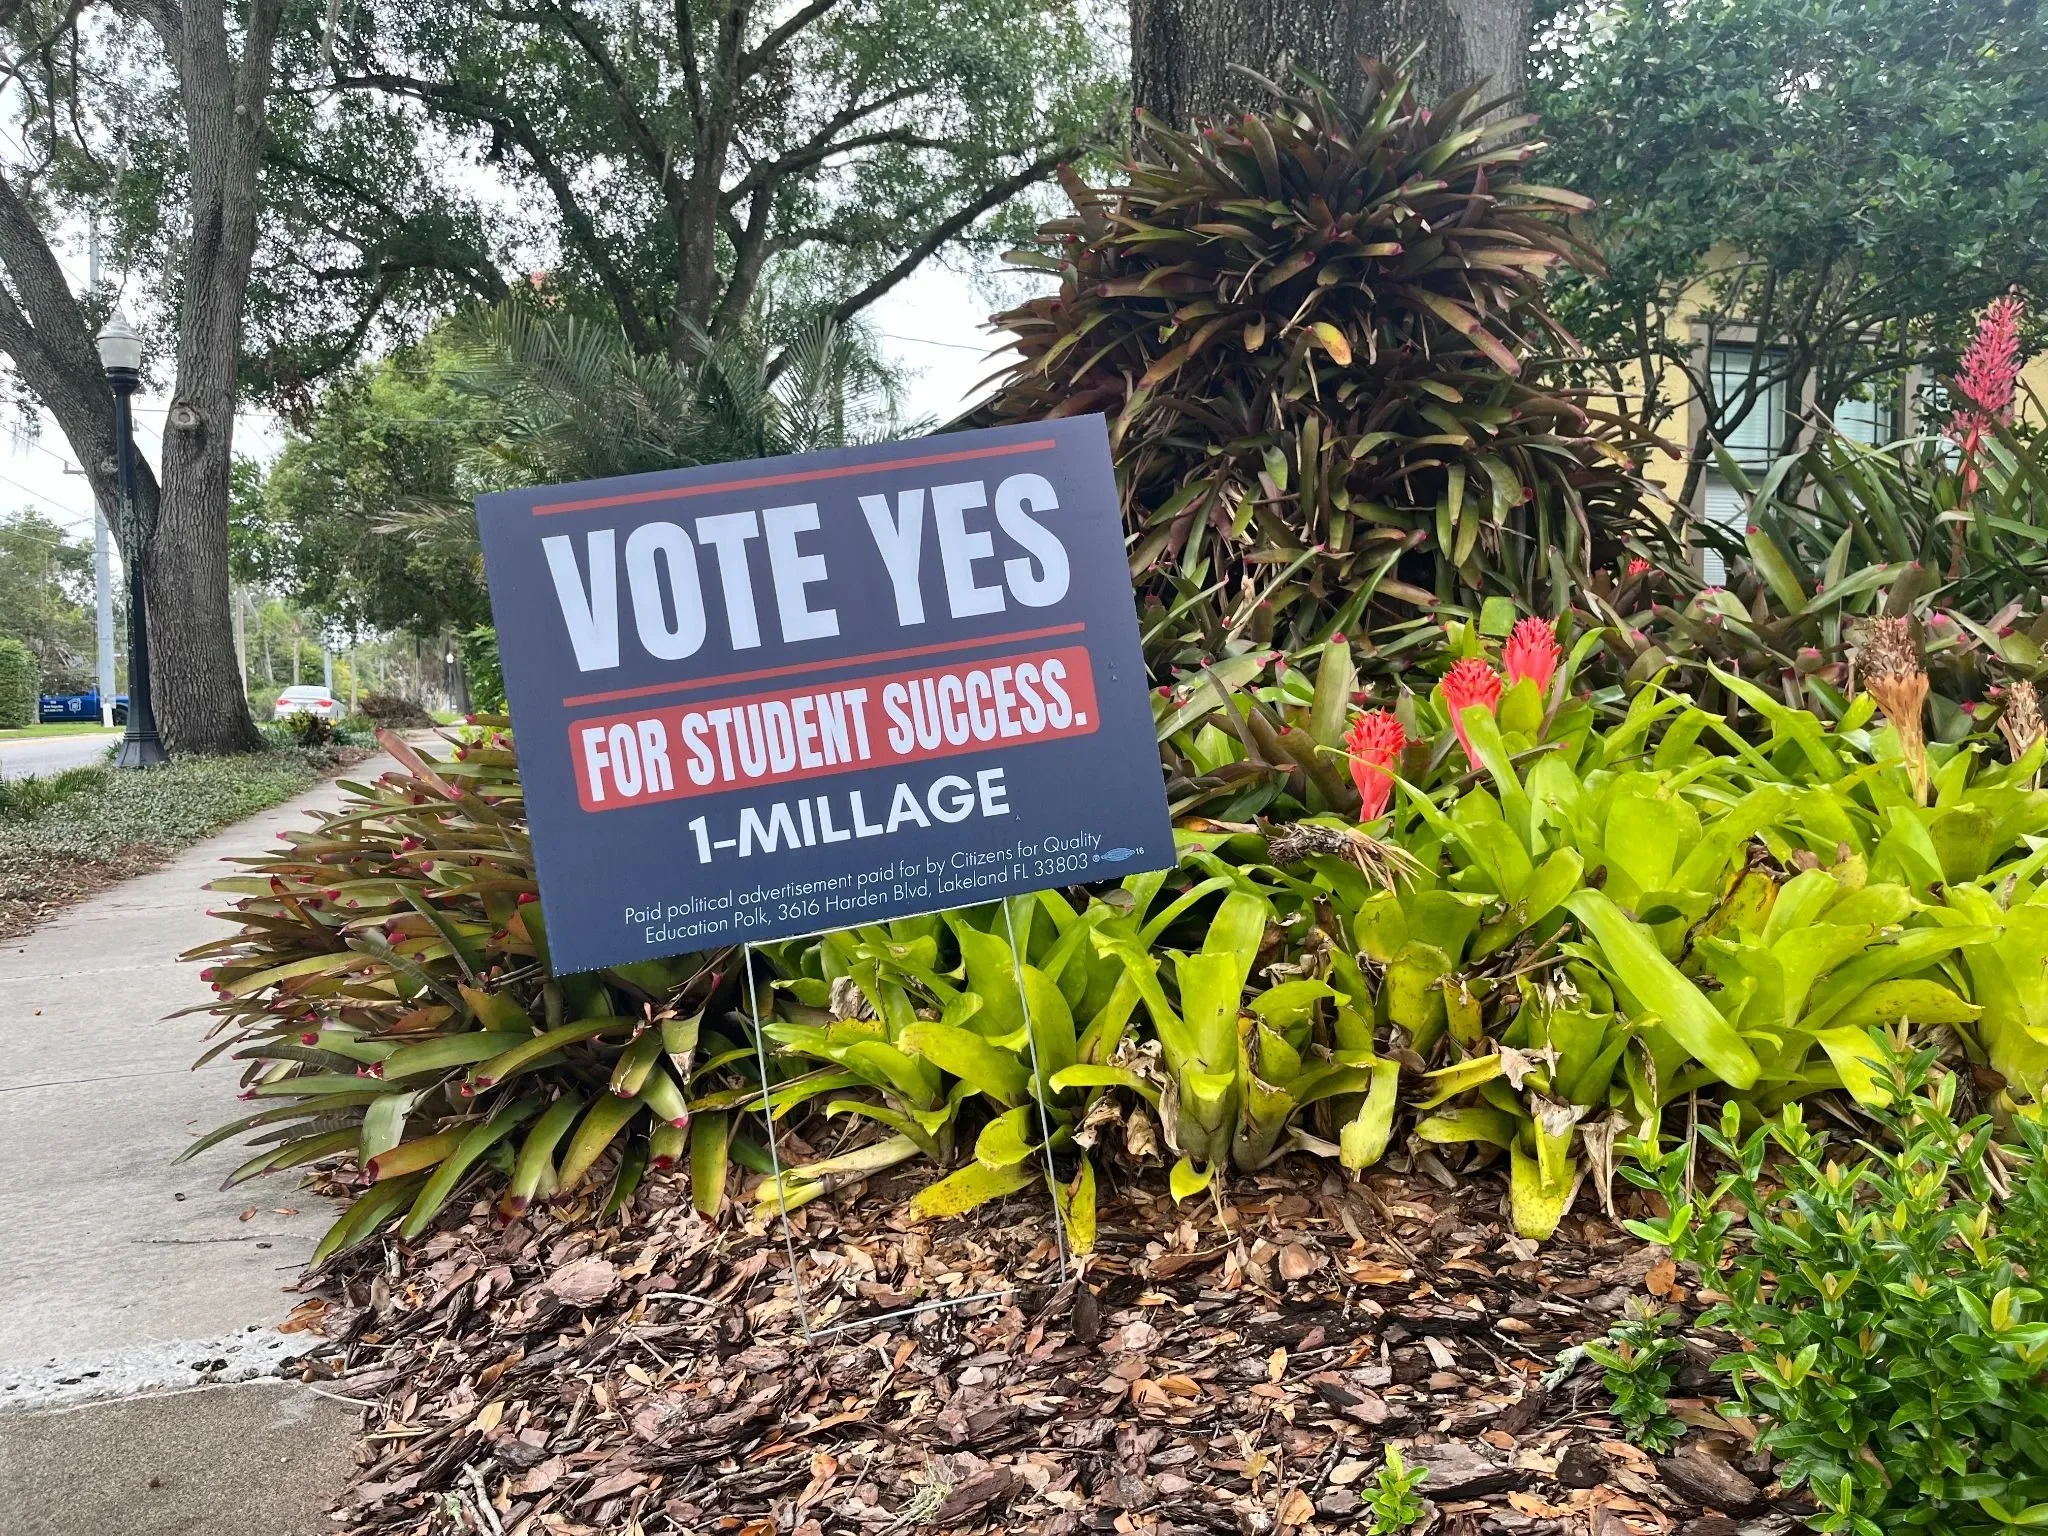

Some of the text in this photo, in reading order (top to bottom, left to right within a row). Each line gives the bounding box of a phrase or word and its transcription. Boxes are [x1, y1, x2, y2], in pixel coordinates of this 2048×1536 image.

[541, 473, 1070, 672] VOTE YES
[582, 658, 1088, 802] FOR STUDENT SUCCESS.
[688, 767, 1010, 864] 1-MILLAGE
[625, 830, 1101, 924] Paid political advertisement paid for by Citizens for Quality
[645, 919, 728, 944] Education
[734, 907, 772, 929] Polk,
[778, 899, 820, 921] 3616
[825, 889, 888, 914] Harden
[893, 882, 932, 902] Blvd,
[938, 866, 1008, 893] Lakeland
[1013, 865, 1029, 881] FL
[1034, 852, 1088, 877] 33803
